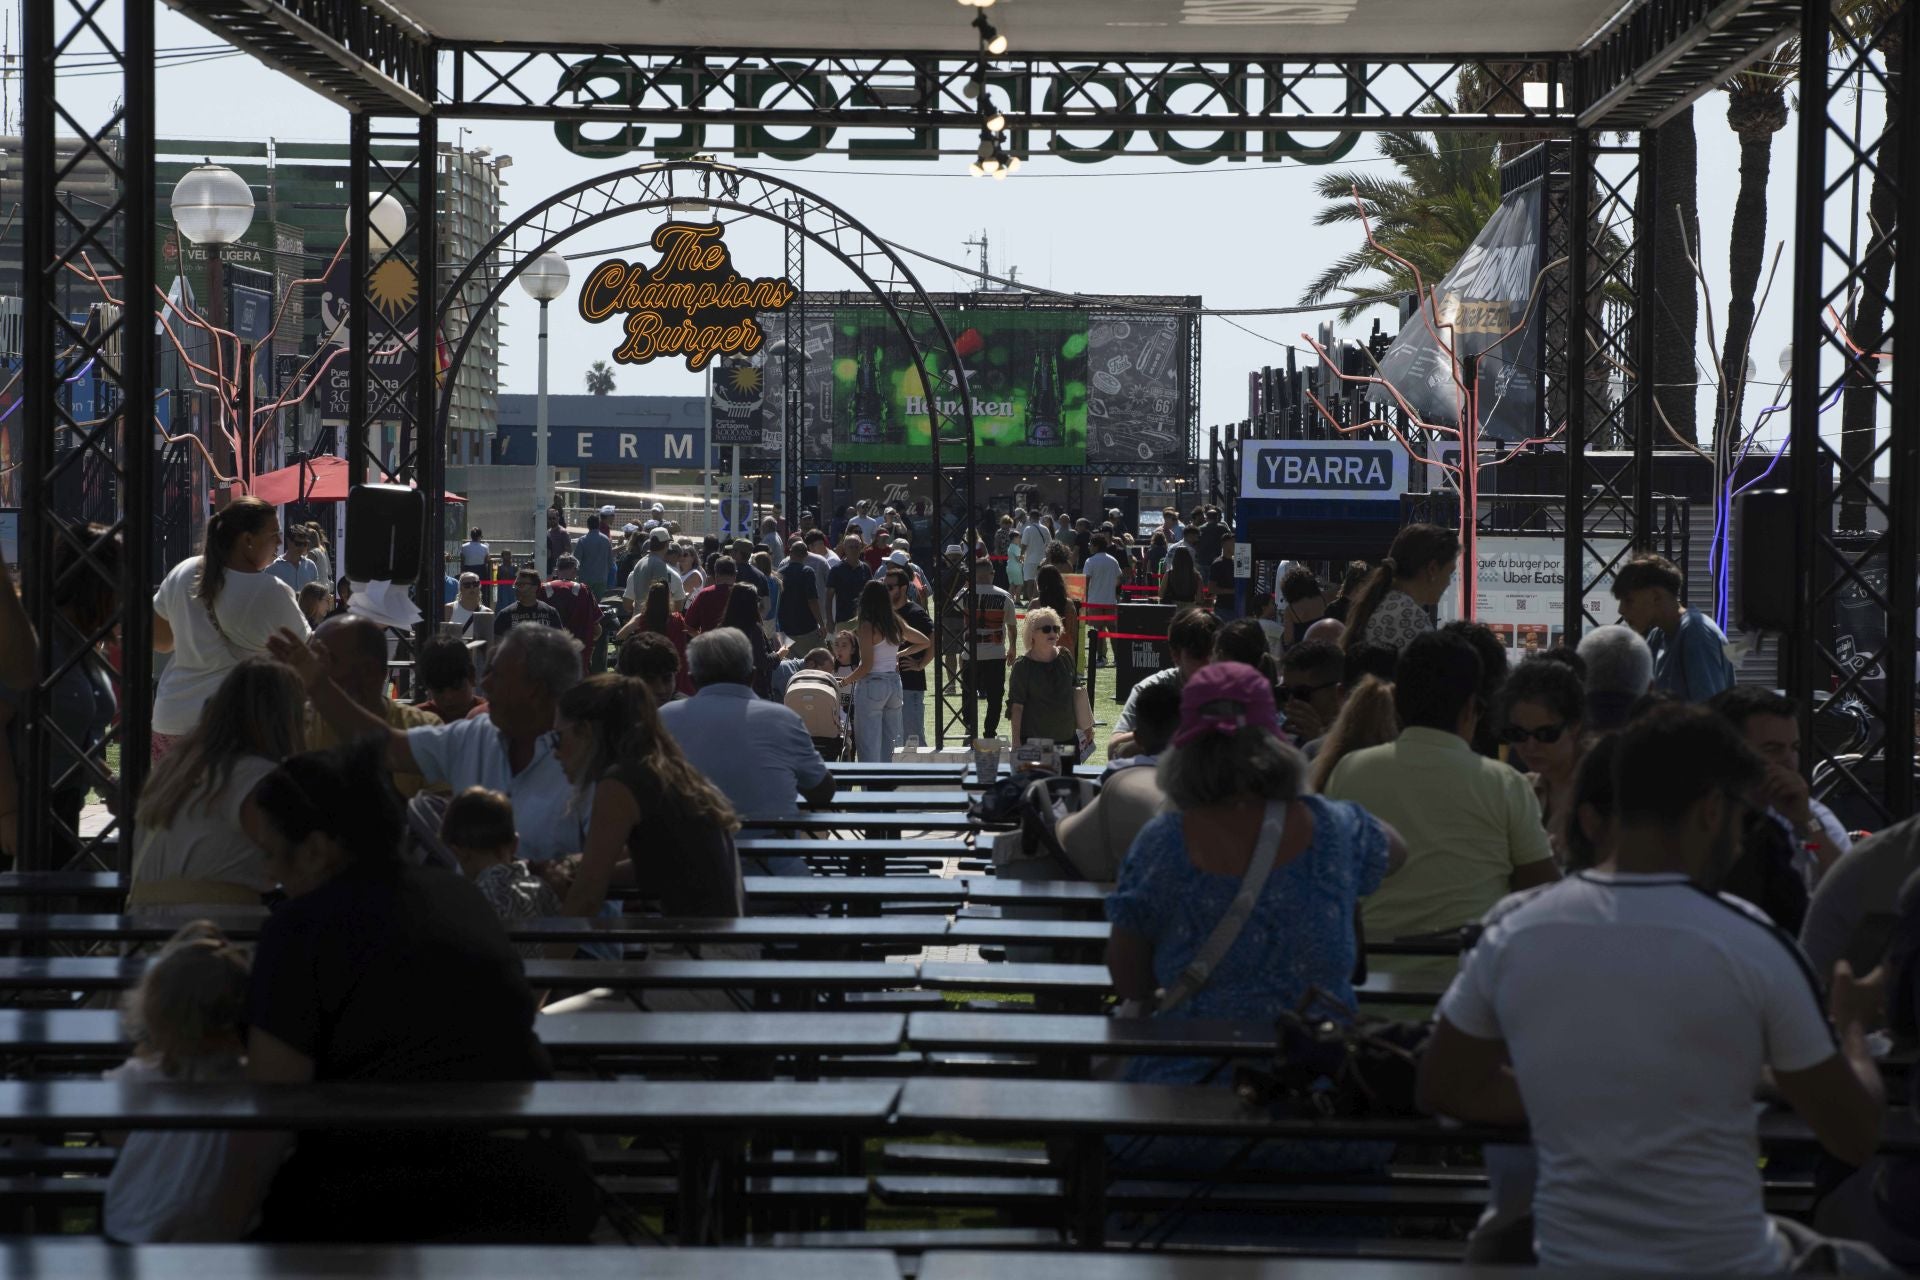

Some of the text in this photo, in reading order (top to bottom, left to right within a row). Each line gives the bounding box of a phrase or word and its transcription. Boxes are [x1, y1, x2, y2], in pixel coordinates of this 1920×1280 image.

[188, 250, 208, 260] VEL
[653, 225, 726, 281] The
[584, 263, 794, 319] Champions
[617, 311, 762, 369] Burger
[1264, 456, 1386, 485] YBARRA
[1498, 559, 1508, 568] tu
[1509, 558, 1541, 570] burger
[1543, 560, 1560, 570] por
[1503, 571, 1565, 584] Uber Eats
